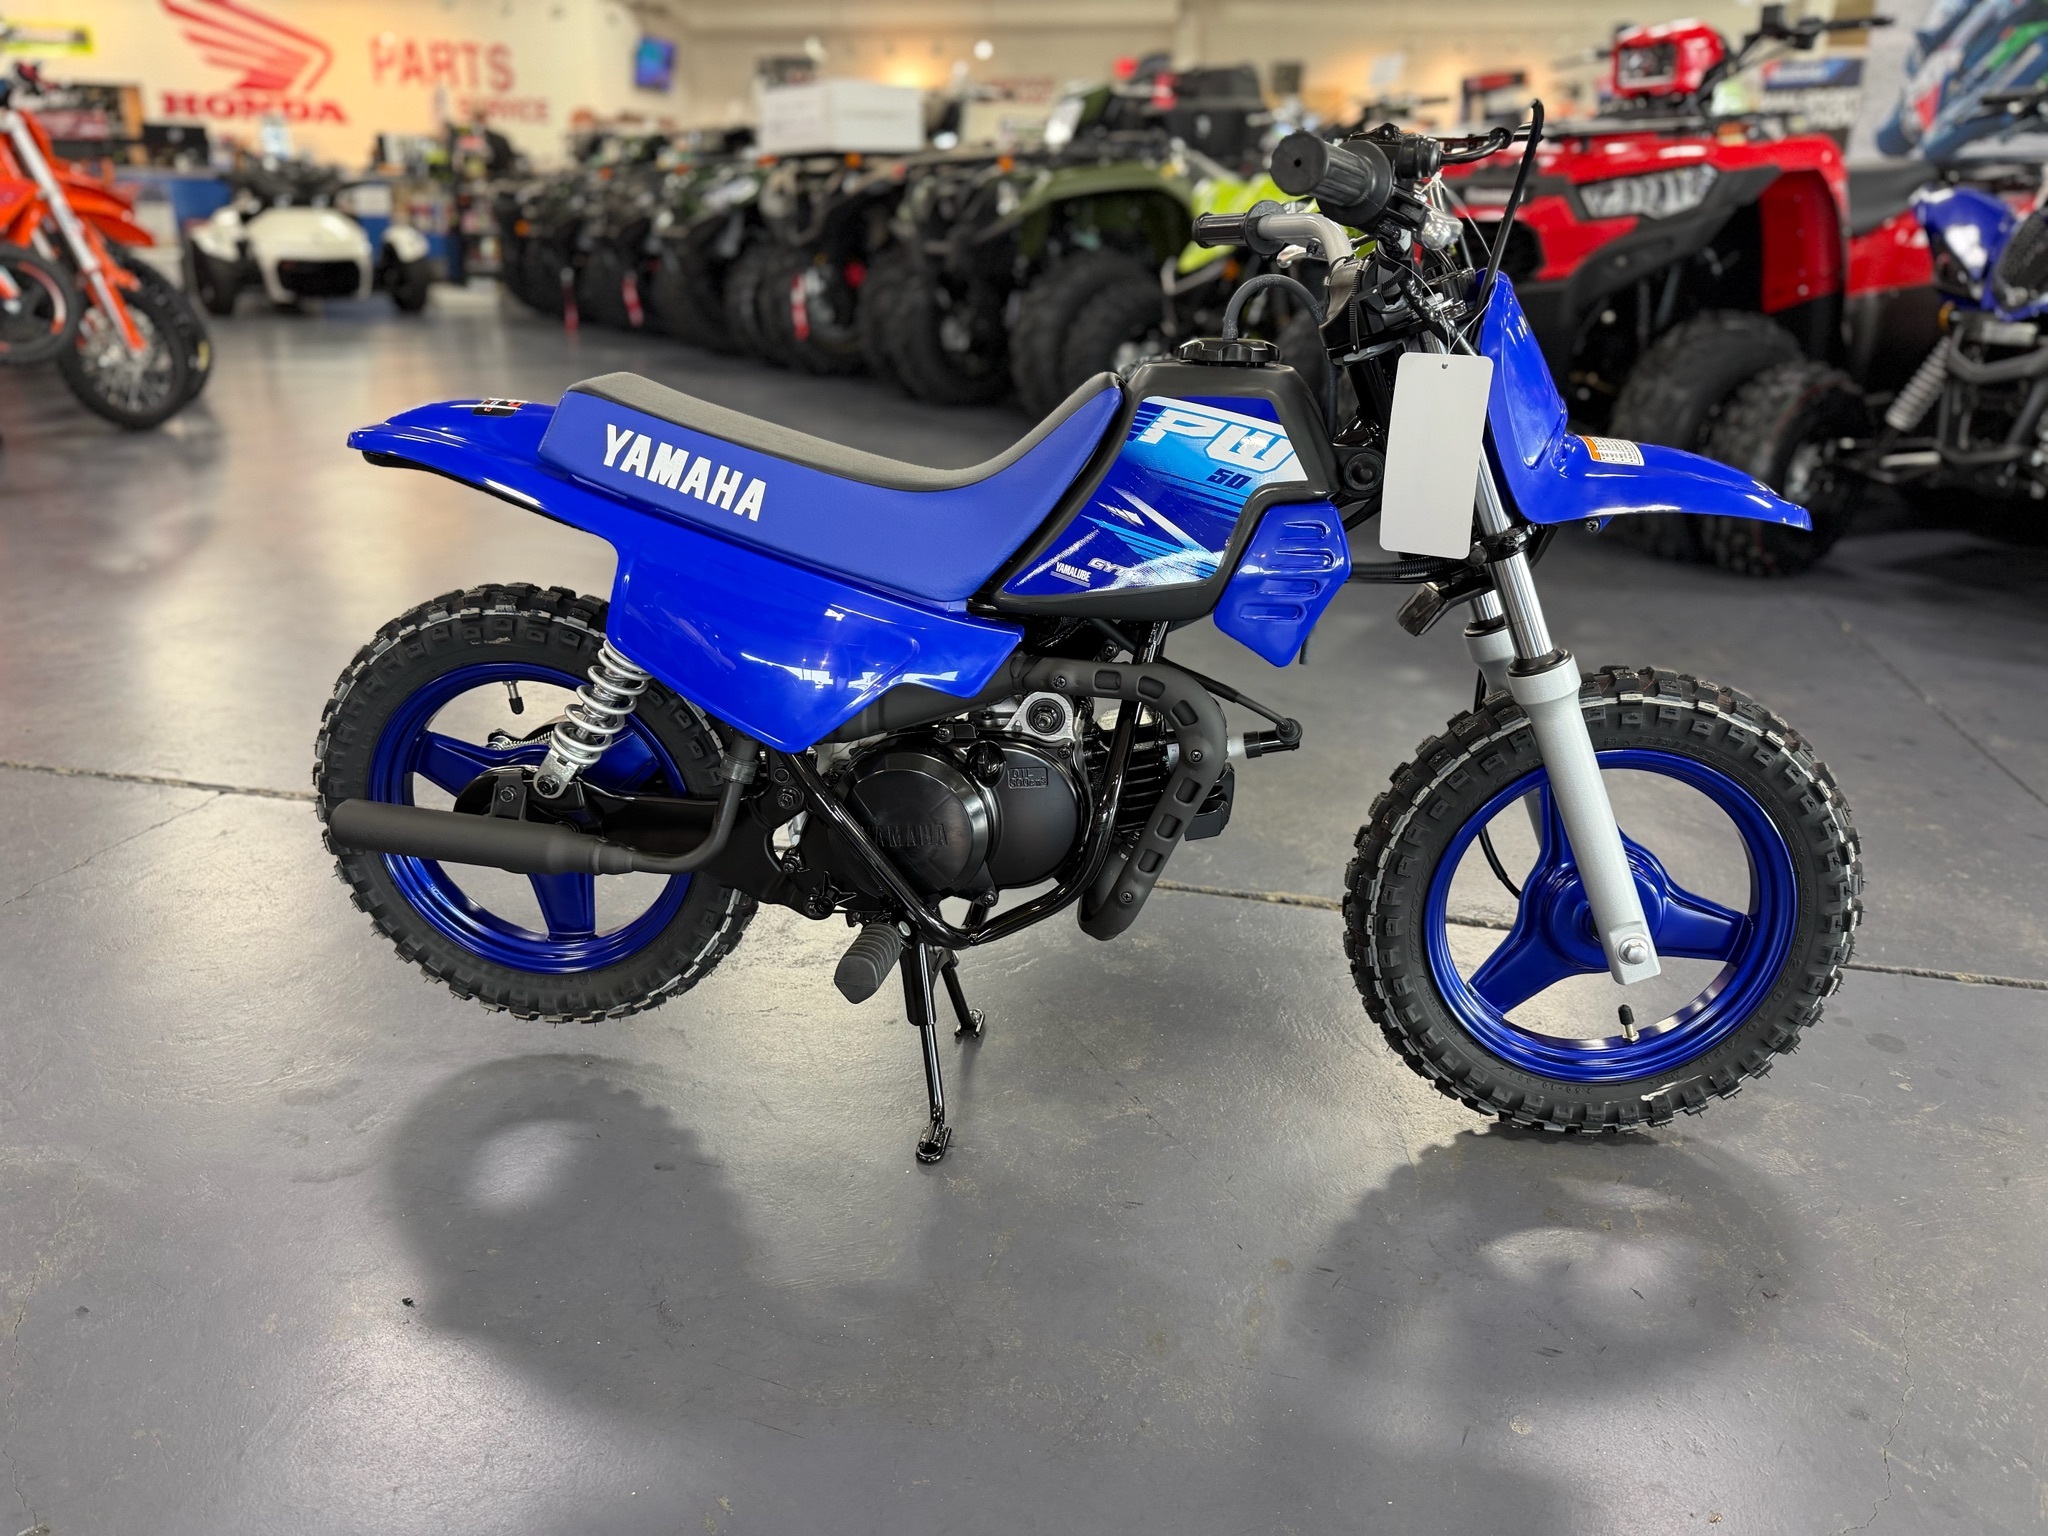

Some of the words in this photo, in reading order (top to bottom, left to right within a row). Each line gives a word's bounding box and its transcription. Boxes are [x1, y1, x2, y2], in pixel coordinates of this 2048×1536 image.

[372, 38, 514, 90] PARTS
[161, 92, 347, 123] HONDA
[1137, 408, 1294, 473] PW
[603, 423, 767, 522] YAMAHA
[1206, 468, 1252, 490] 50
[1055, 561, 1092, 582] YAMALUBE
[1088, 557, 1140, 582] GYT
[1012, 768, 1034, 778] OIL
[864, 822, 950, 848] AMAHA
